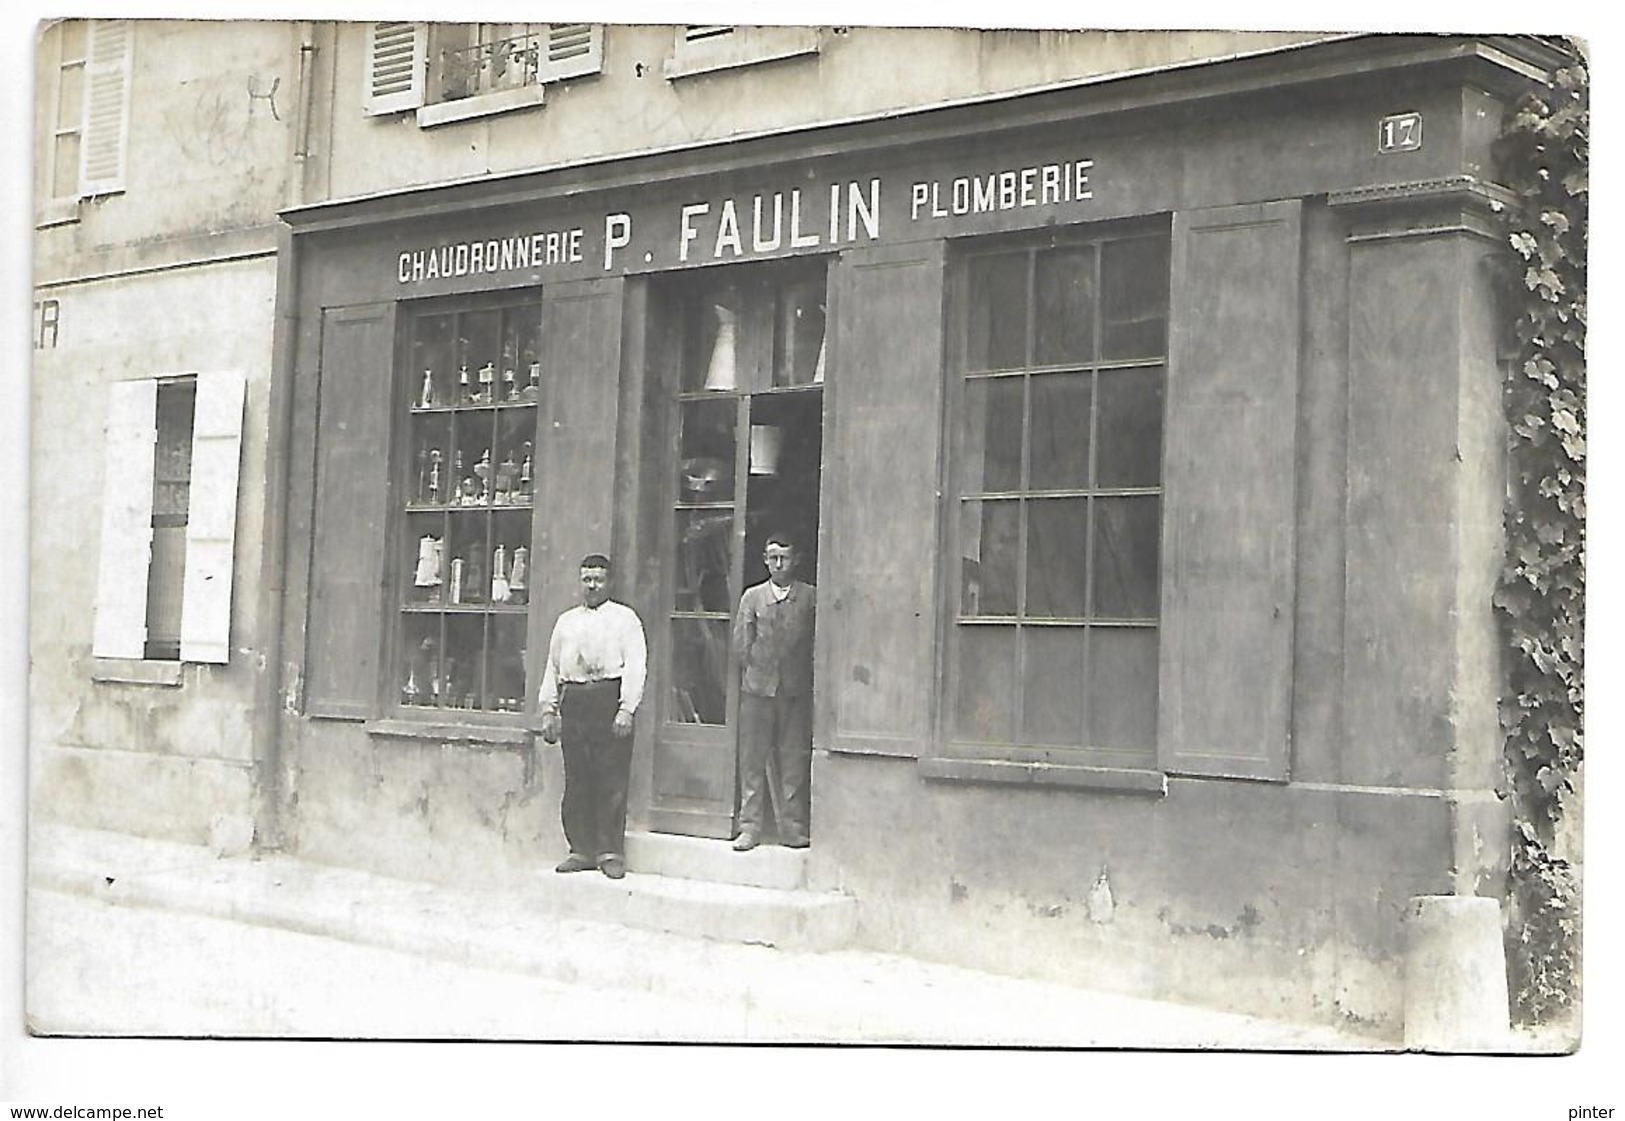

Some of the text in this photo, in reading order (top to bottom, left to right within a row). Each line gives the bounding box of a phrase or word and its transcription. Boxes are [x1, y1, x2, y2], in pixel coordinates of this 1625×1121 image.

[1384, 118, 1416, 148] 17
[398, 160, 1095, 284] CHAUDRONNERIE P. FAULIN PLOMBERIE
[33, 300, 60, 349] R
